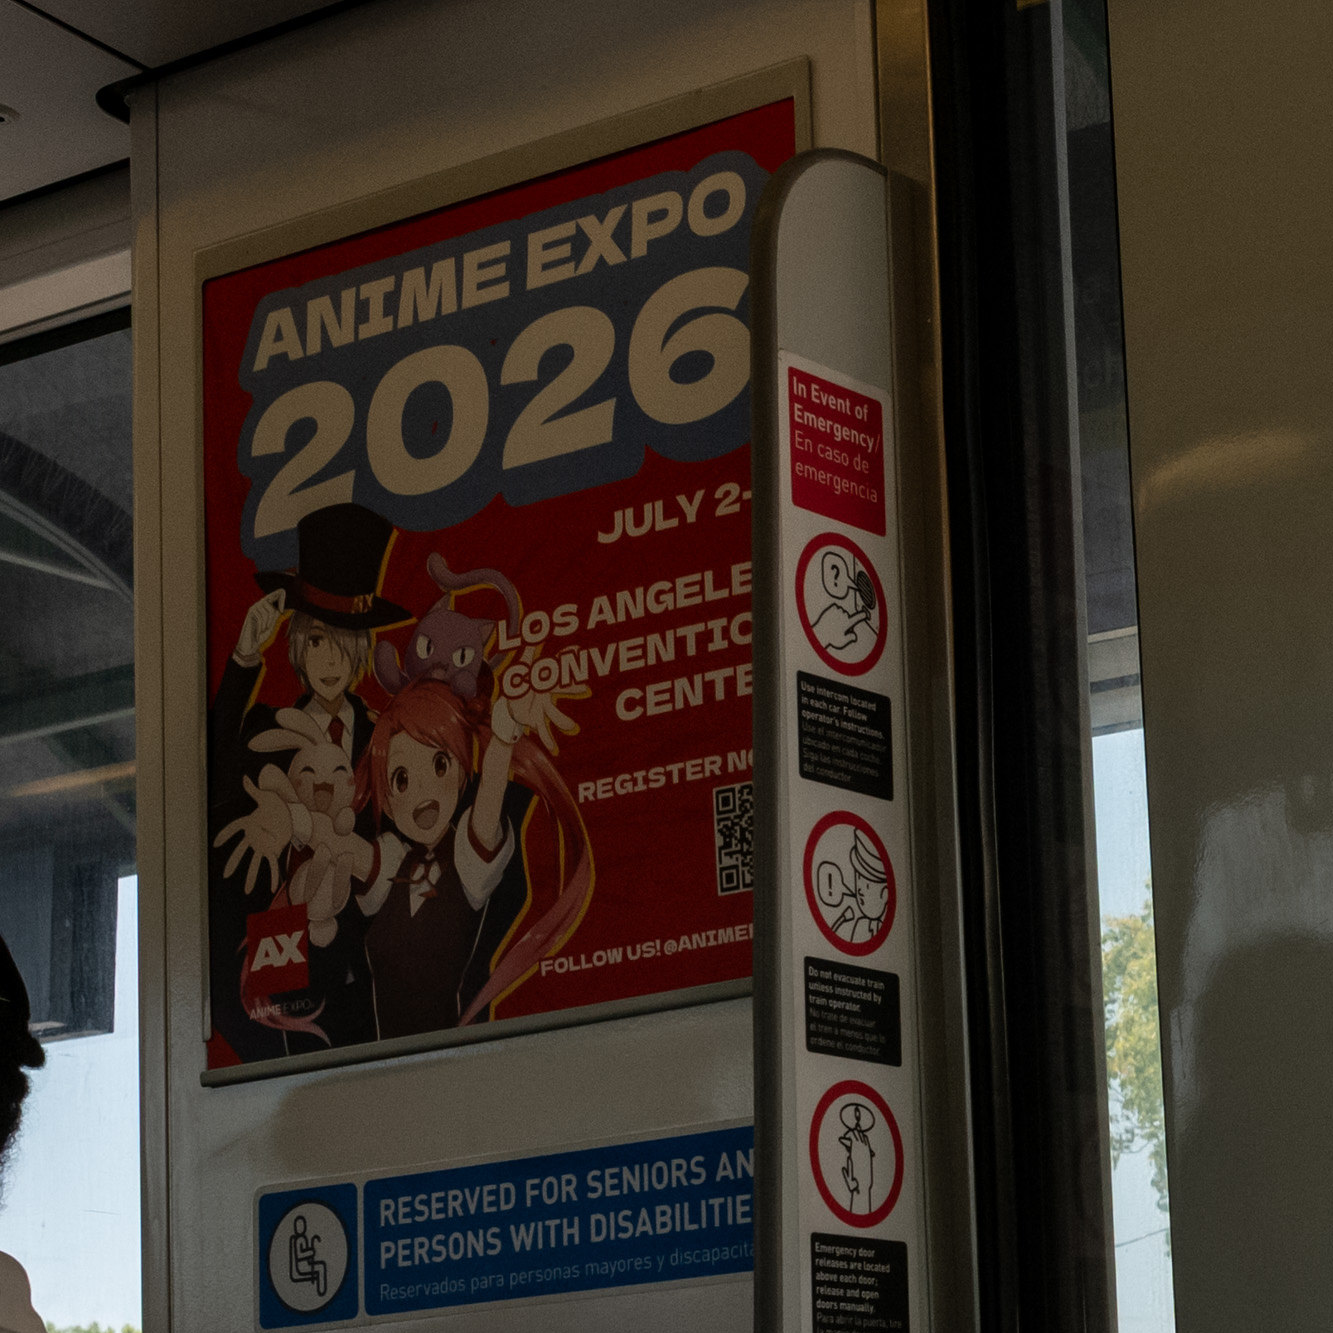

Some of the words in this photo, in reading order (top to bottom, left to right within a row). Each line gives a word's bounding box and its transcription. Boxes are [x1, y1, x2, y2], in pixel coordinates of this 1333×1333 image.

[253, 240, 511, 372] ANIME
[526, 170, 747, 290] EXPO
[250, 267, 750, 538] 2026
[792, 376, 807, 399] In
[811, 383, 852, 415] Event
[854, 404, 869, 422] of
[794, 429, 813, 453] En
[817, 443, 850, 467] caso
[853, 453, 869, 474] de
[795, 461, 878, 503] emergencia
[597, 489, 706, 544] JULY
[498, 603, 579, 651] LOS
[578, 755, 723, 803] REGISTER
[727, 749, 753, 773] N
[250, 930, 307, 973] AX
[541, 947, 623, 976] FOLLOW
[626, 940, 661, 961] US!
[808, 965, 819, 977] Do
[820, 970, 832, 980] not
[808, 981, 834, 993] unless
[809, 994, 828, 1005] train
[380, 1181, 516, 1227] RESERVED
[526, 1173, 578, 1207] FOR
[586, 1154, 706, 1199] SENIORS
[380, 1227, 502, 1270] PERSONS
[510, 1216, 581, 1252] WITH
[590, 1194, 752, 1244] DISABILITIE
[814, 1242, 857, 1259] Emergency
[858, 1247, 876, 1258] door
[380, 1273, 466, 1301] Reservados
[470, 1273, 504, 1294] para
[510, 1264, 580, 1290] personas
[585, 1254, 653, 1280] mayores
[657, 1254, 666, 1273] y
[816, 1258, 848, 1270] releases
[849, 1261, 862, 1271] are
[863, 1261, 890, 1273] located
[816, 1271, 838, 1282] above
[840, 1273, 857, 1283] each
[816, 1285, 844, 1297] release
[846, 1287, 860, 1298] and
[861, 1290, 879, 1301] open
[816, 1299, 838, 1310] doors
